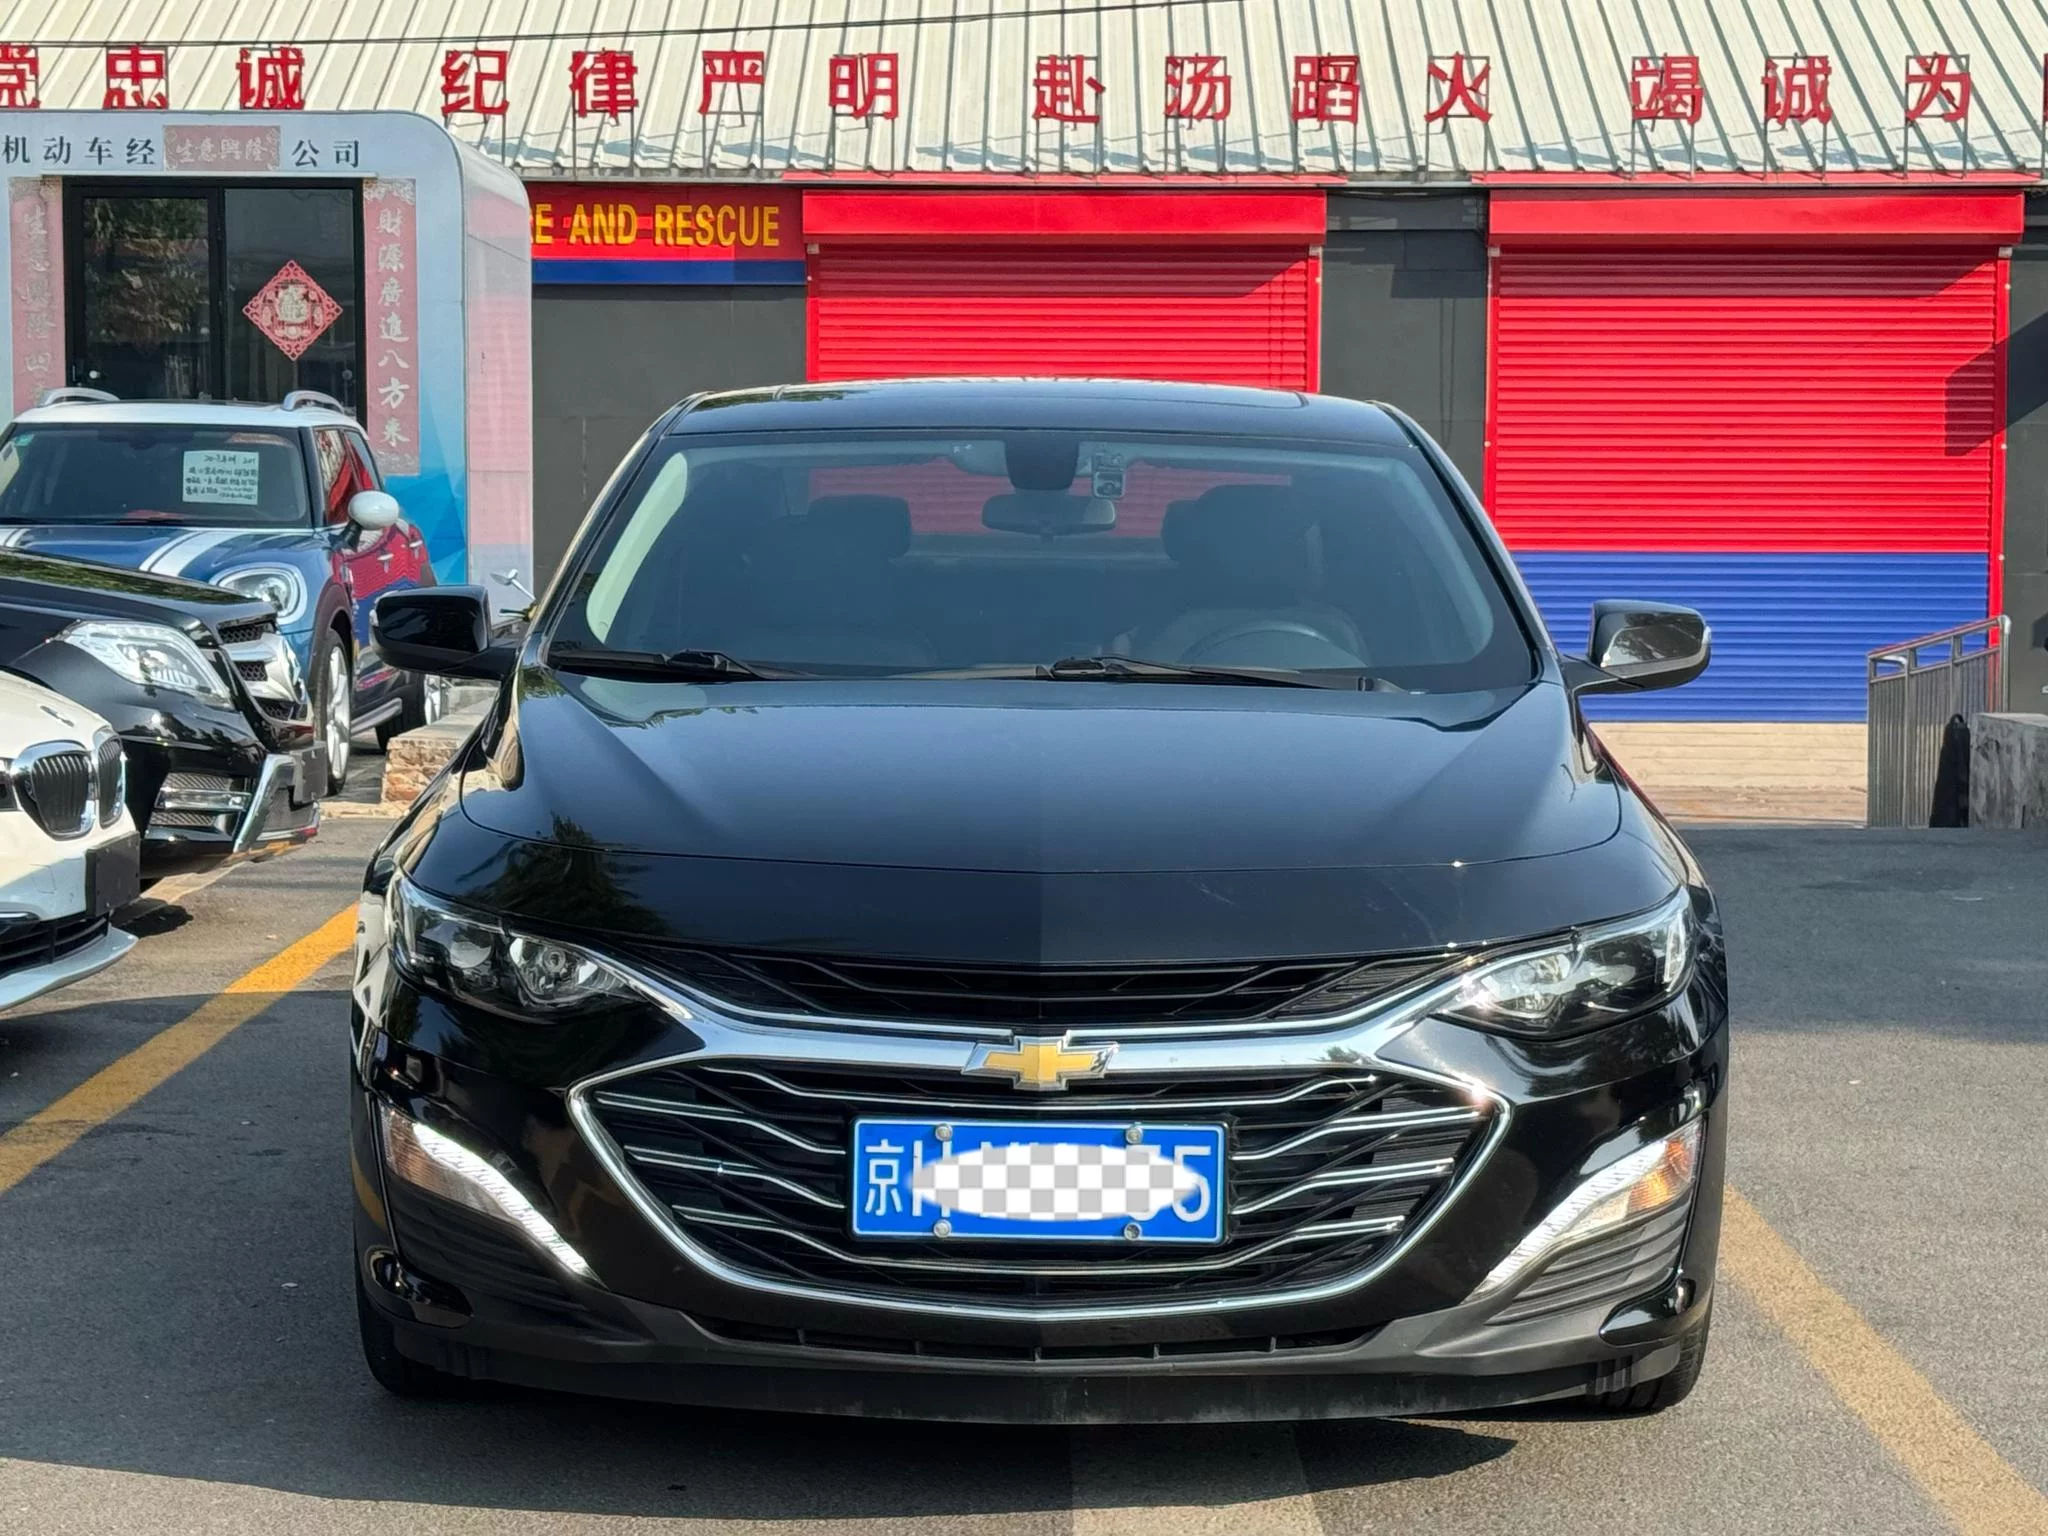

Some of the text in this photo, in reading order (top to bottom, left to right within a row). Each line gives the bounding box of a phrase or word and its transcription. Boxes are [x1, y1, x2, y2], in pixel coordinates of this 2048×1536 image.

[441, 48, 899, 119] 纪律严明
[1033, 53, 1493, 124] 赴汤蹈火
[531, 203, 780, 247] E AND RESCUE
